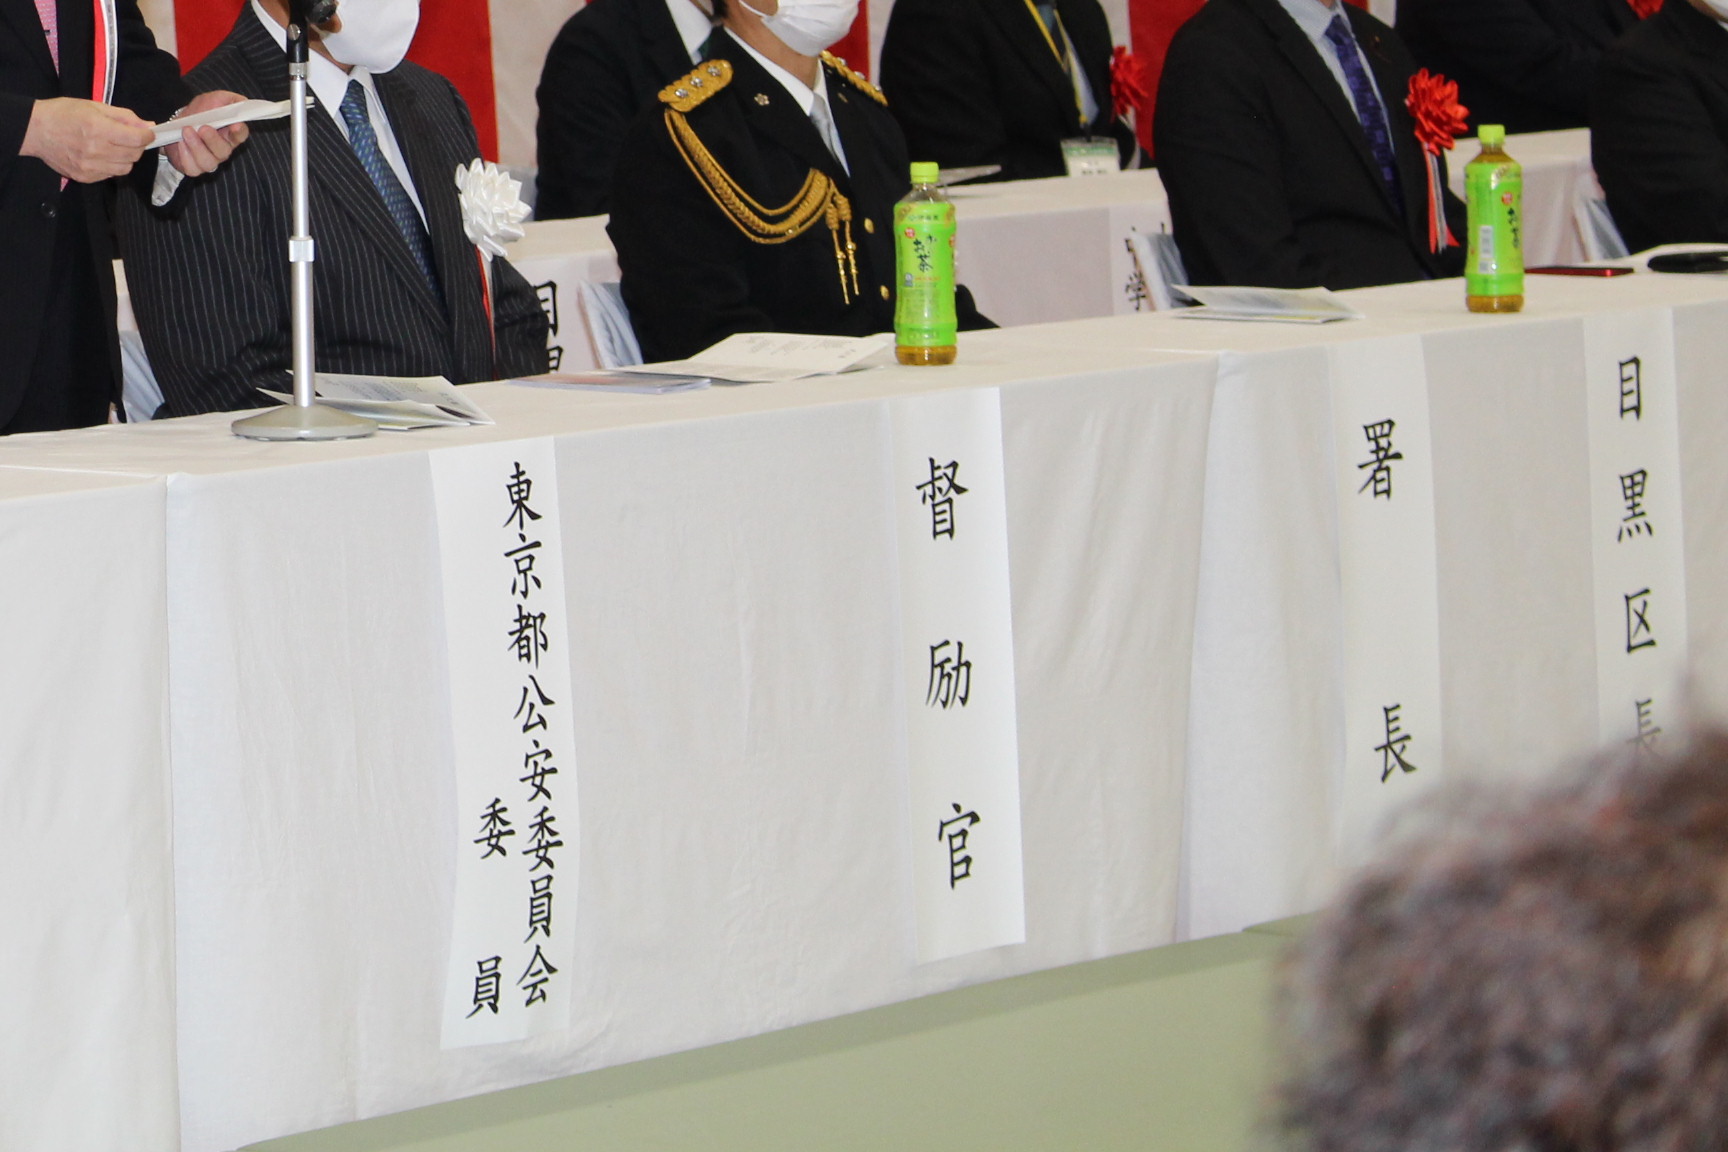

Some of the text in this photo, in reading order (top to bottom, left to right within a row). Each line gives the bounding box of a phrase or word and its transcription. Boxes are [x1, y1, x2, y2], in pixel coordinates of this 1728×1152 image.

[501, 461, 564, 1013] 東京都公安委員会
[915, 457, 981, 889] 督励官
[1357, 418, 1417, 783] 署長
[466, 797, 516, 1019] 委員
